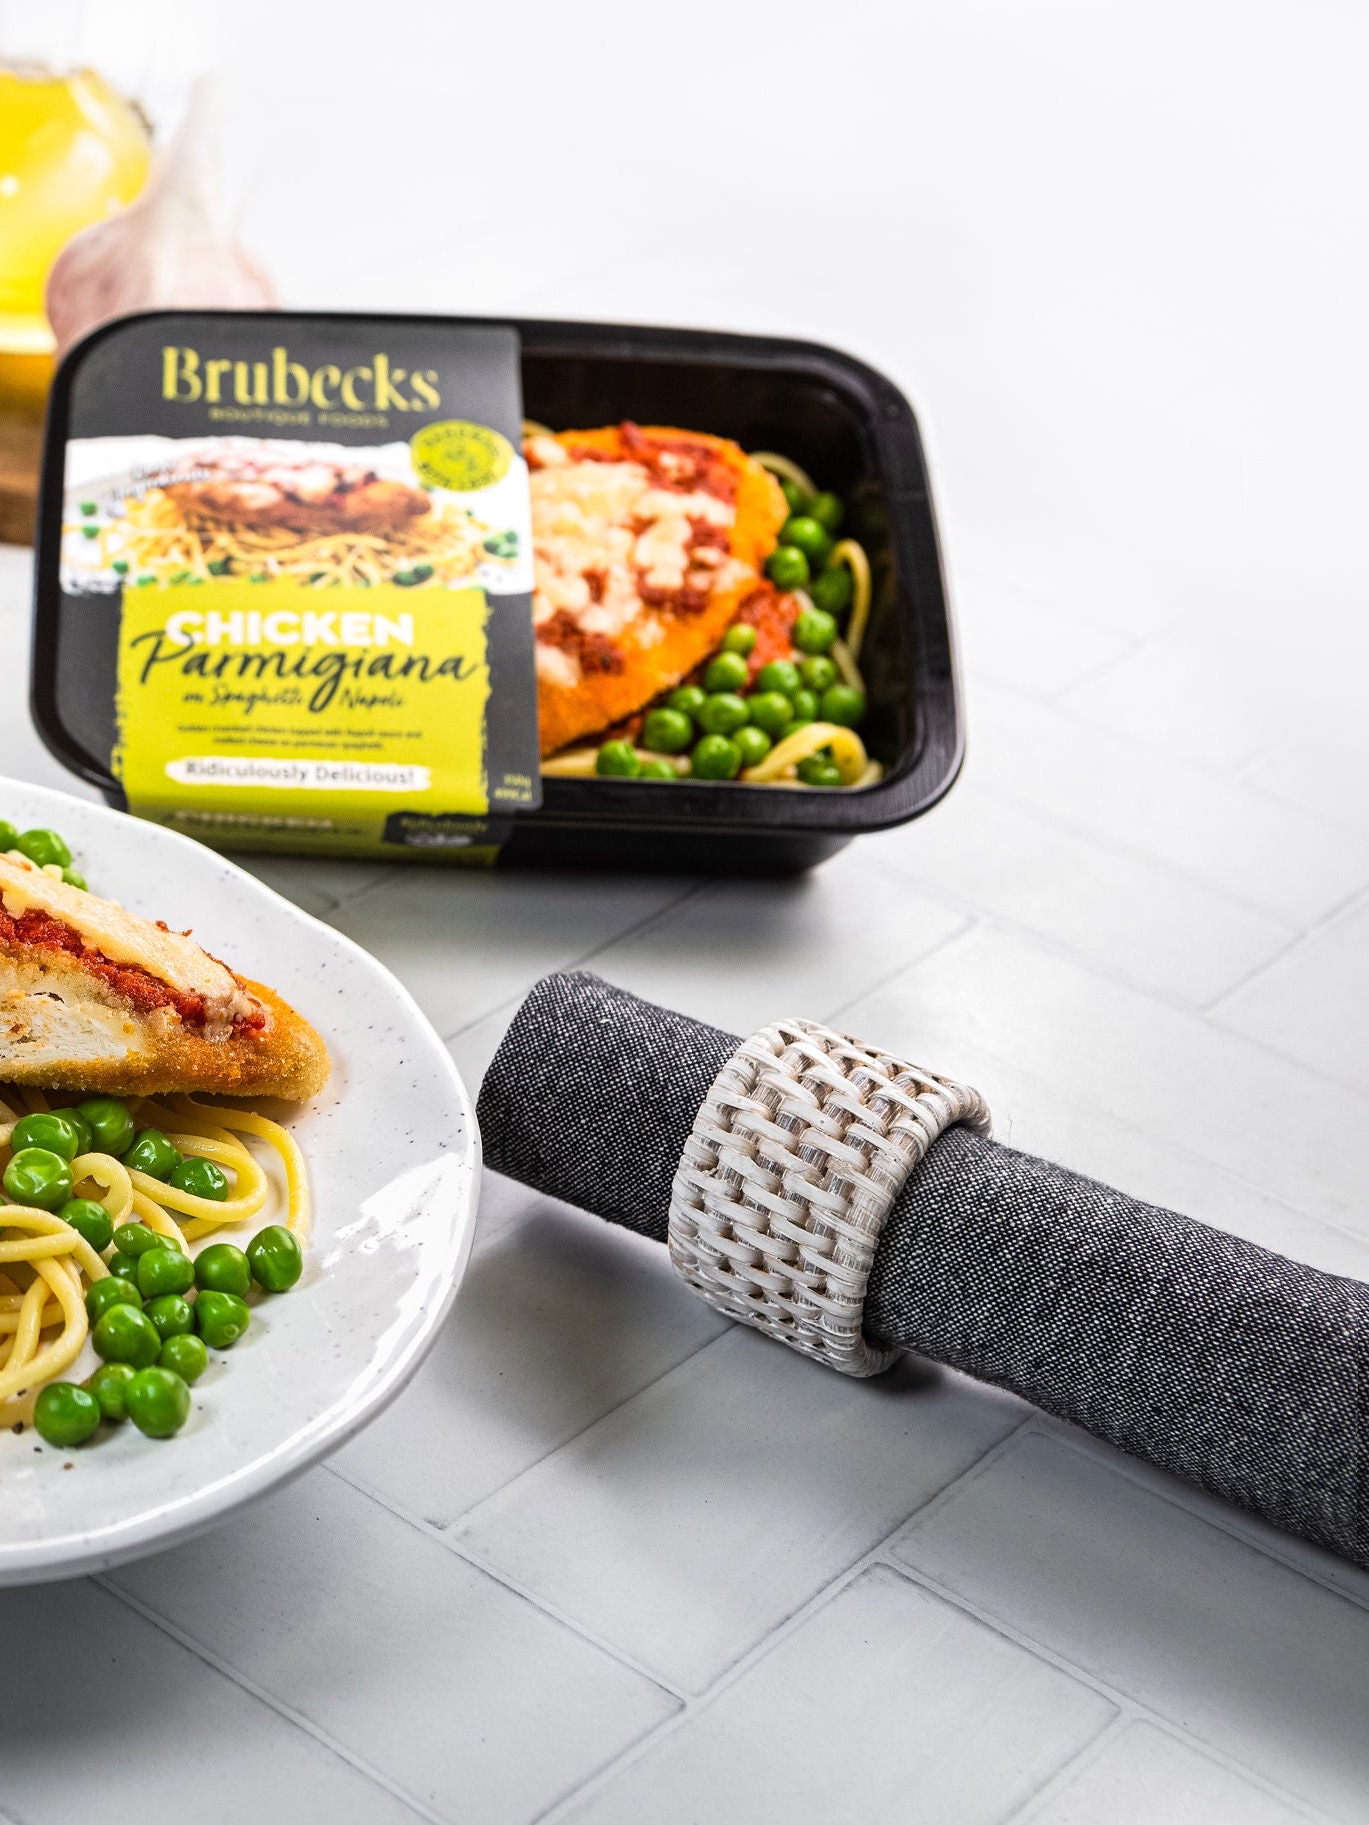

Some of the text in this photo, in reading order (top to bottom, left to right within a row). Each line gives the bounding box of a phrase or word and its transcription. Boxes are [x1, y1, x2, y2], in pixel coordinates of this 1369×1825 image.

[162, 346, 441, 412] Brubecks
[317, 411, 390, 429] FOODS
[165, 610, 414, 646] CHICKEN
[129, 630, 478, 713] Parmigiana
[210, 683, 303, 714] Spaghetti
[339, 686, 404, 710] Napoli
[186, 761, 414, 786] Ridiculously Delicious!
